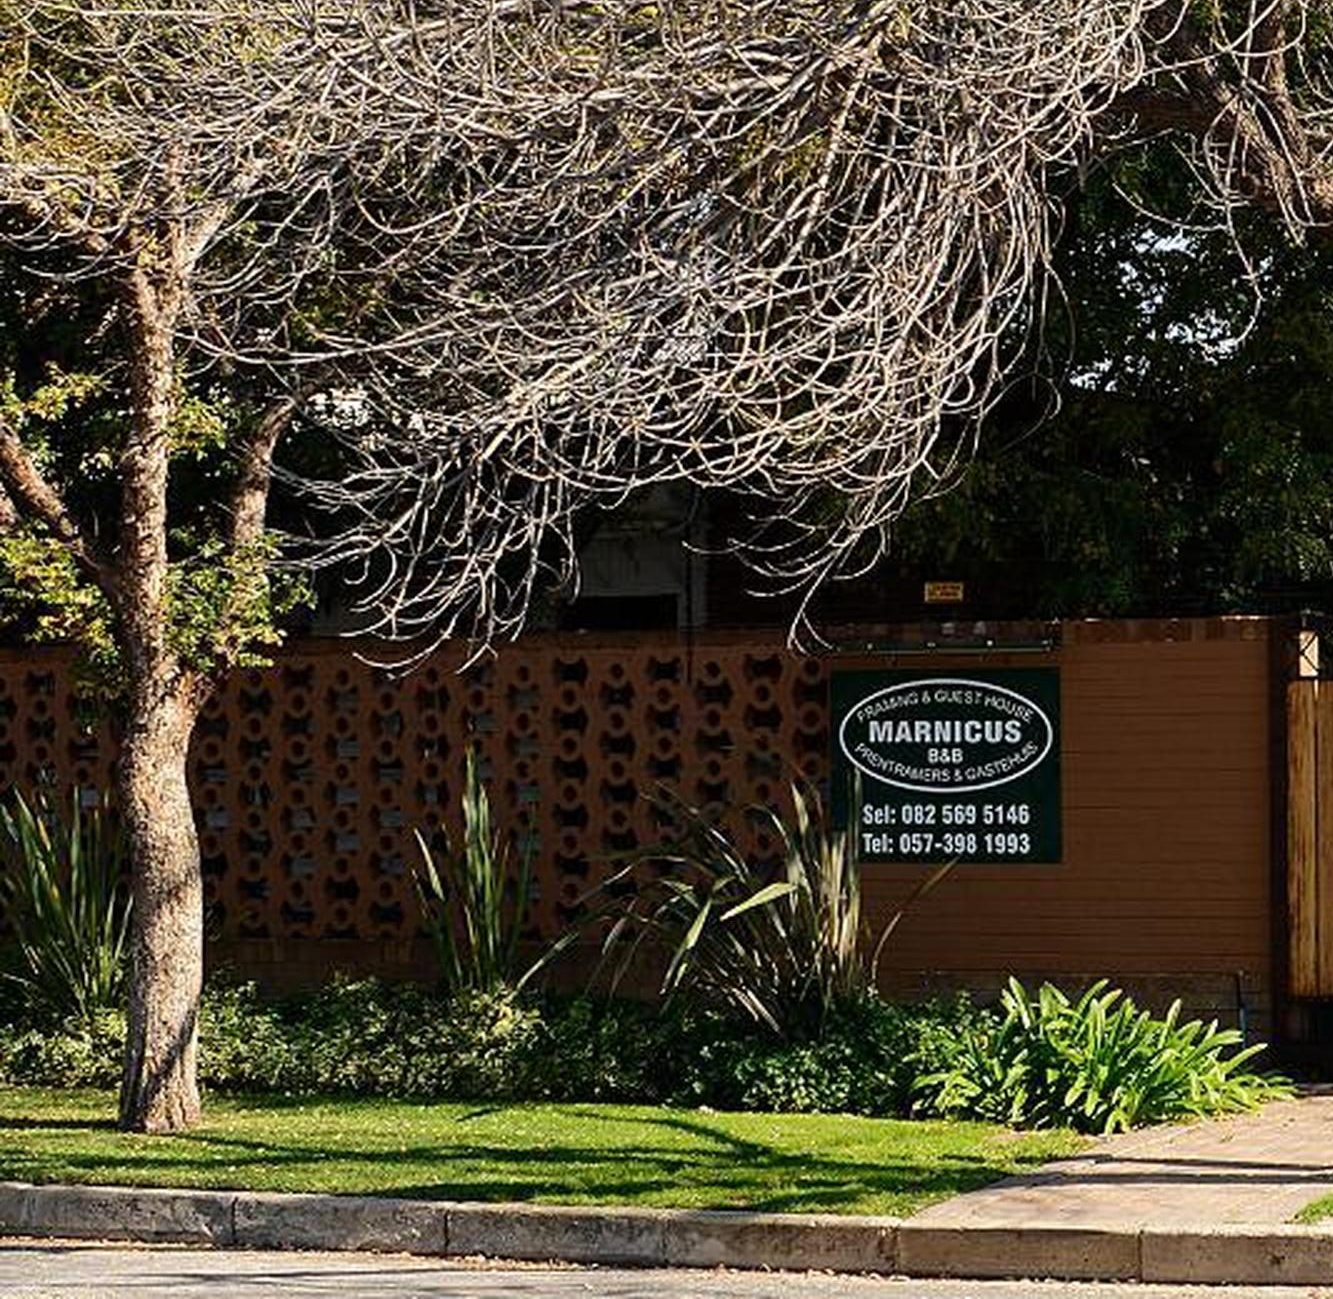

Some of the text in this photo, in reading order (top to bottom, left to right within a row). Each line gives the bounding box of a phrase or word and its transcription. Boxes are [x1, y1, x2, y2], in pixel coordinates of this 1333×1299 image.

[921, 690, 931, 705] &
[934, 689, 983, 705] GUEST
[984, 695, 1035, 724] HOUSE
[868, 720, 1022, 743] MARNICUS
[927, 747, 964, 764] B&B
[953, 768, 963, 783] &
[862, 803, 1030, 825] Sel: 082 569 5146
[862, 832, 1031, 854] Tel: 057-398 1993
